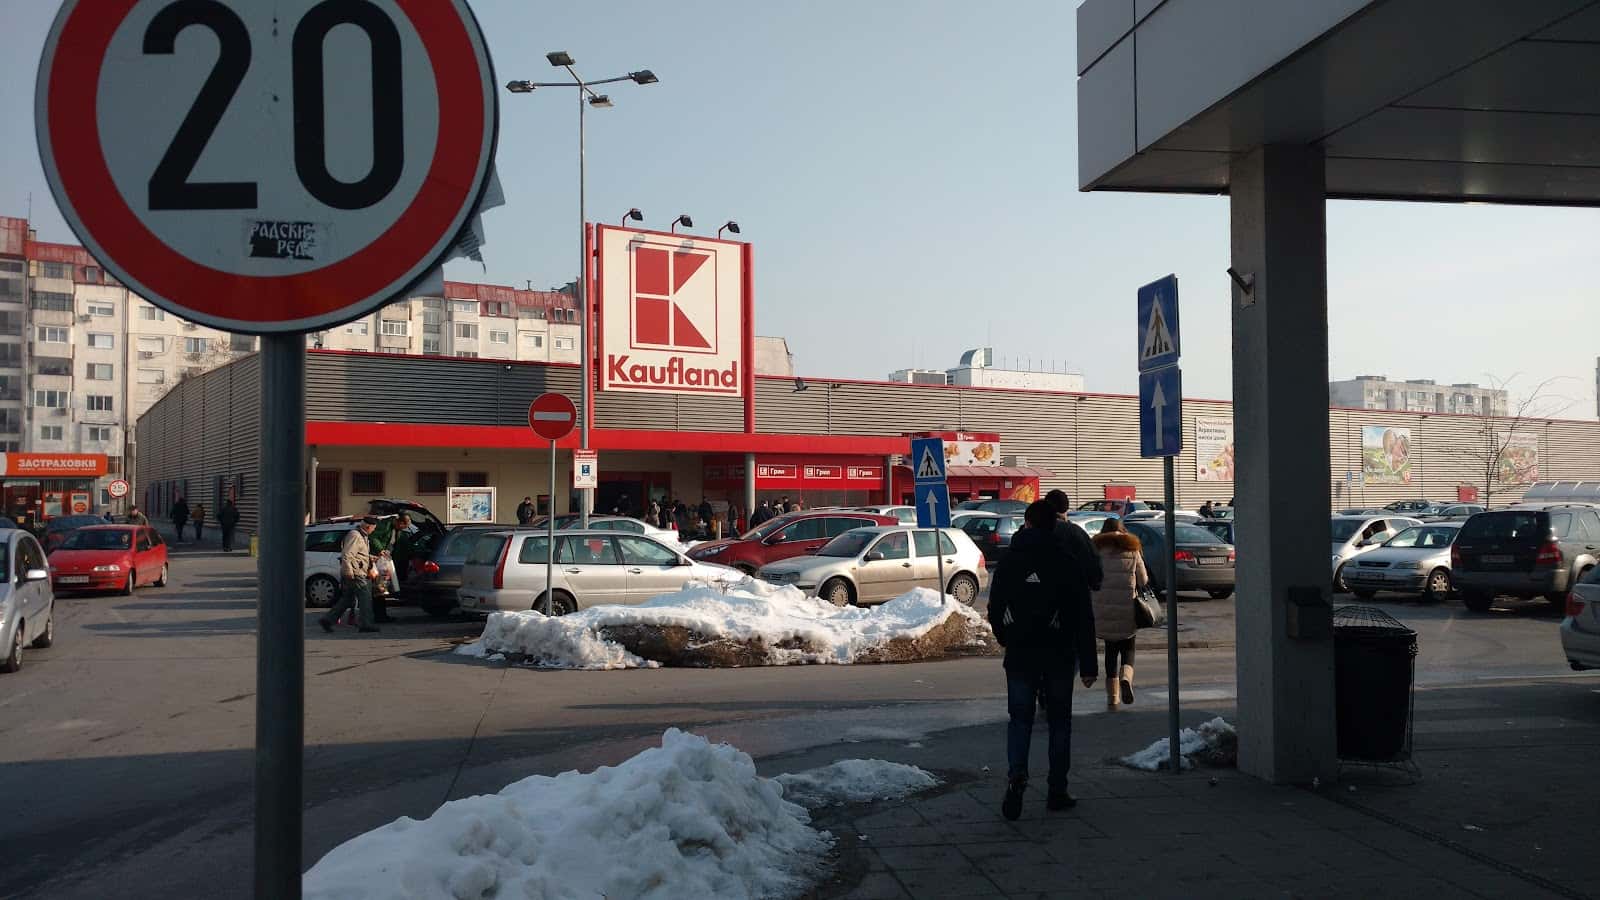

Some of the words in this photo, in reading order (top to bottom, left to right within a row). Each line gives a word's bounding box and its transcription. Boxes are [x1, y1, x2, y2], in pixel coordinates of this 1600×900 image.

[142, 0, 404, 210] 20
[608, 354, 737, 388] Kaufland
[18, 459, 96, 468] ЗАСТРАХОВКИ
